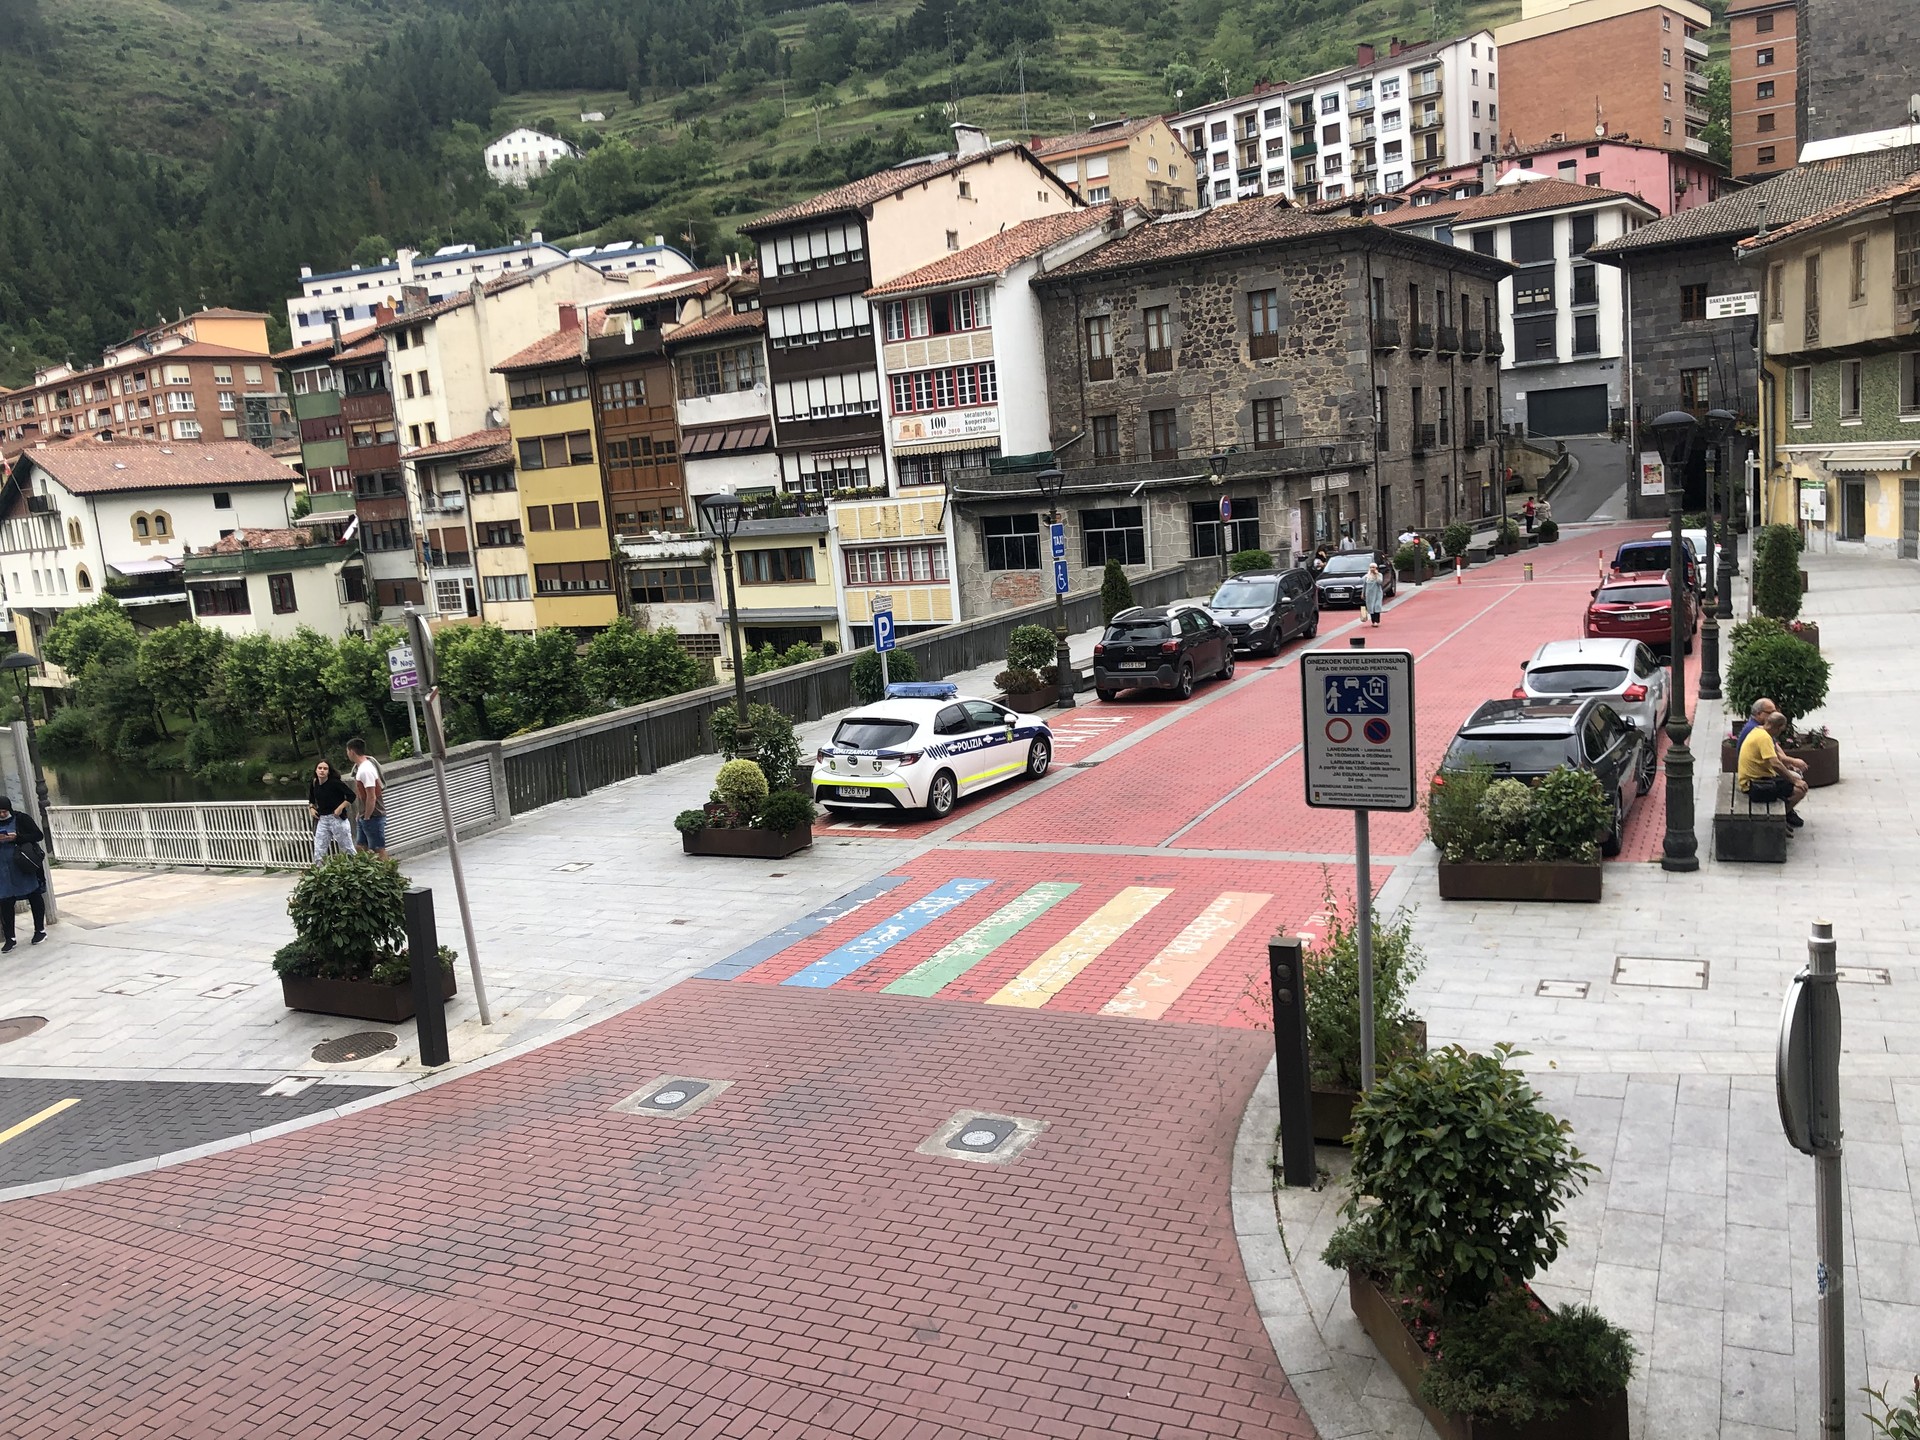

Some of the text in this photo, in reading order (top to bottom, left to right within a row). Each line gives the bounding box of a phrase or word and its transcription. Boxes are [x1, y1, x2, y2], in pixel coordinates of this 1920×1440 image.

[930, 416, 946, 429] 100
[878, 616, 890, 647] P
[957, 738, 983, 751] POLIZIA
